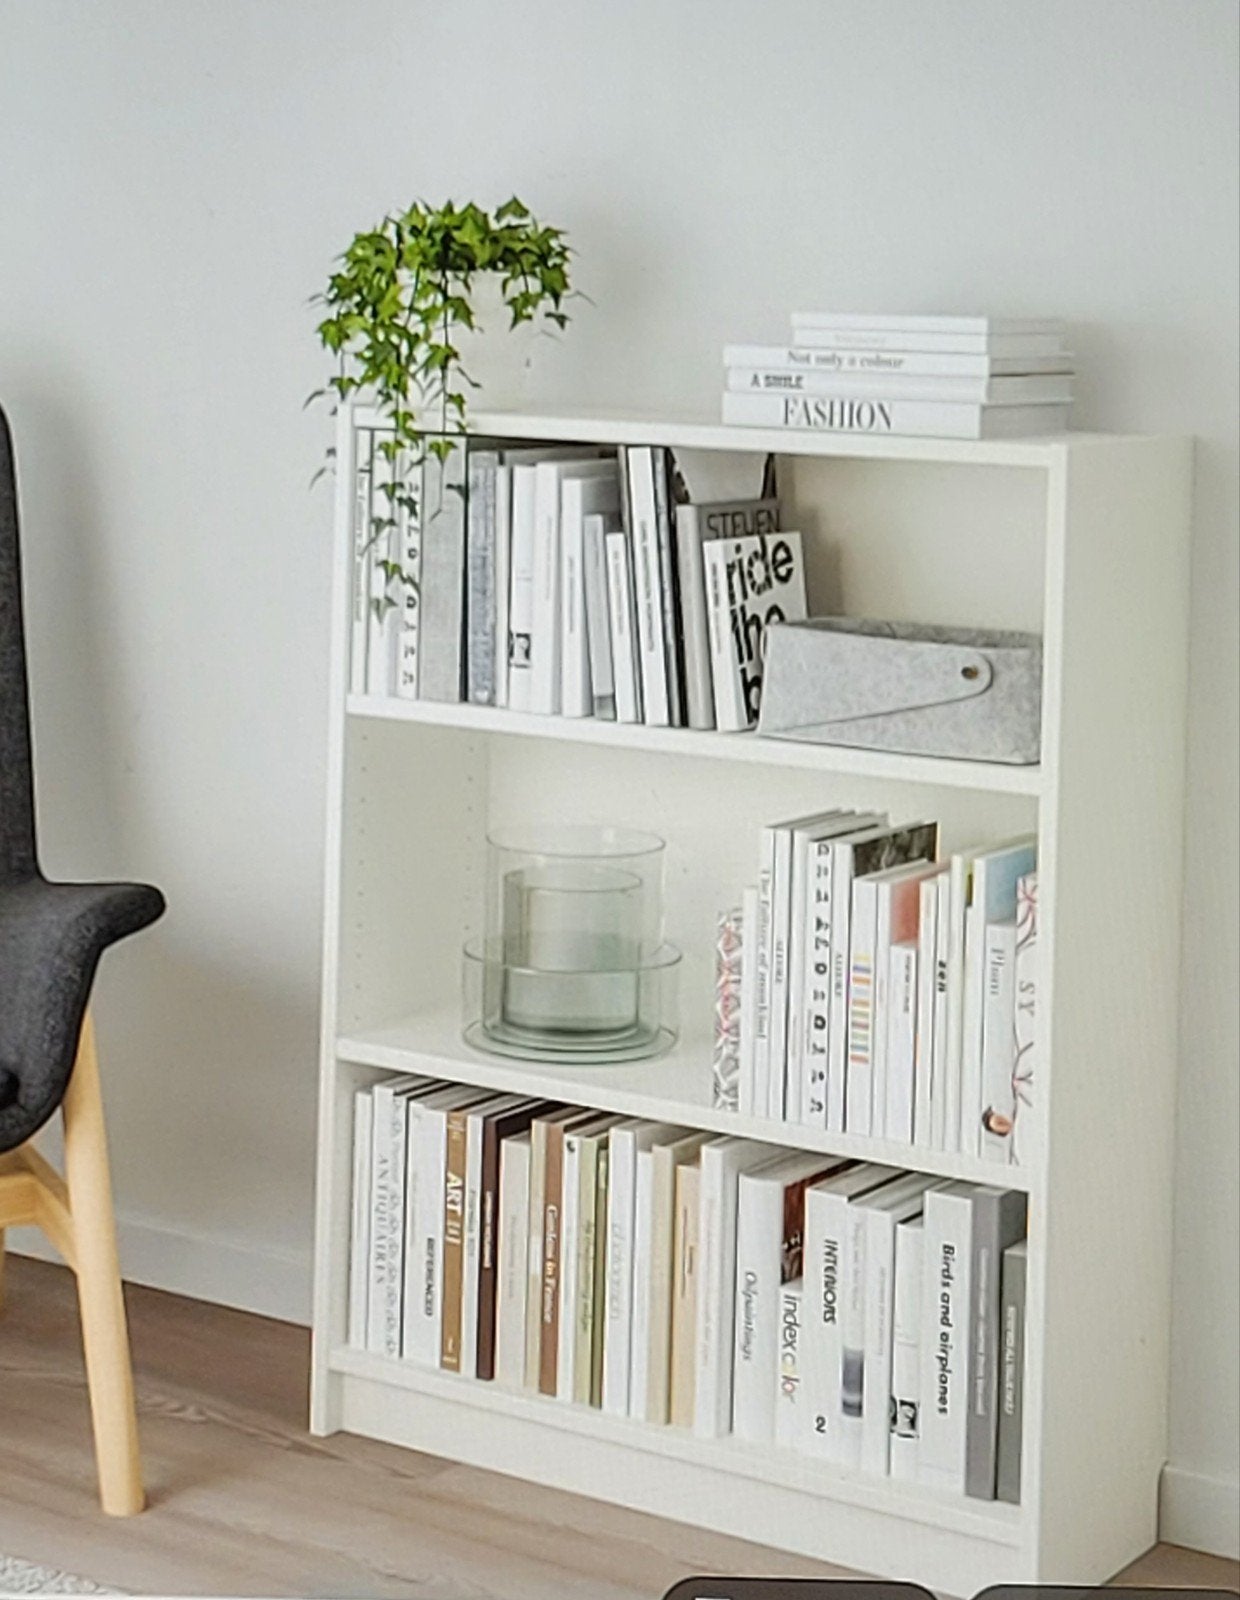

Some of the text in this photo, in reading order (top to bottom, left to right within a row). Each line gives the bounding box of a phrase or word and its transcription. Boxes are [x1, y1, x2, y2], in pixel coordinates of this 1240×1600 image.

[749, 373, 761, 388] A
[787, 350, 811, 365] Not
[814, 353, 843, 371] only
[859, 354, 904, 369] colour
[783, 397, 892, 430] FASHION
[706, 508, 781, 539] STEVEN
[726, 535, 795, 607] ride
[446, 1170, 463, 1216] ART
[374, 1154, 389, 1285] ANTIQUAIRES
[823, 1238, 839, 1325] INTERIORS
[781, 1294, 801, 1351] index
[935, 1243, 956, 1416] Birds and airplanes
[814, 1415, 827, 1434] 2
